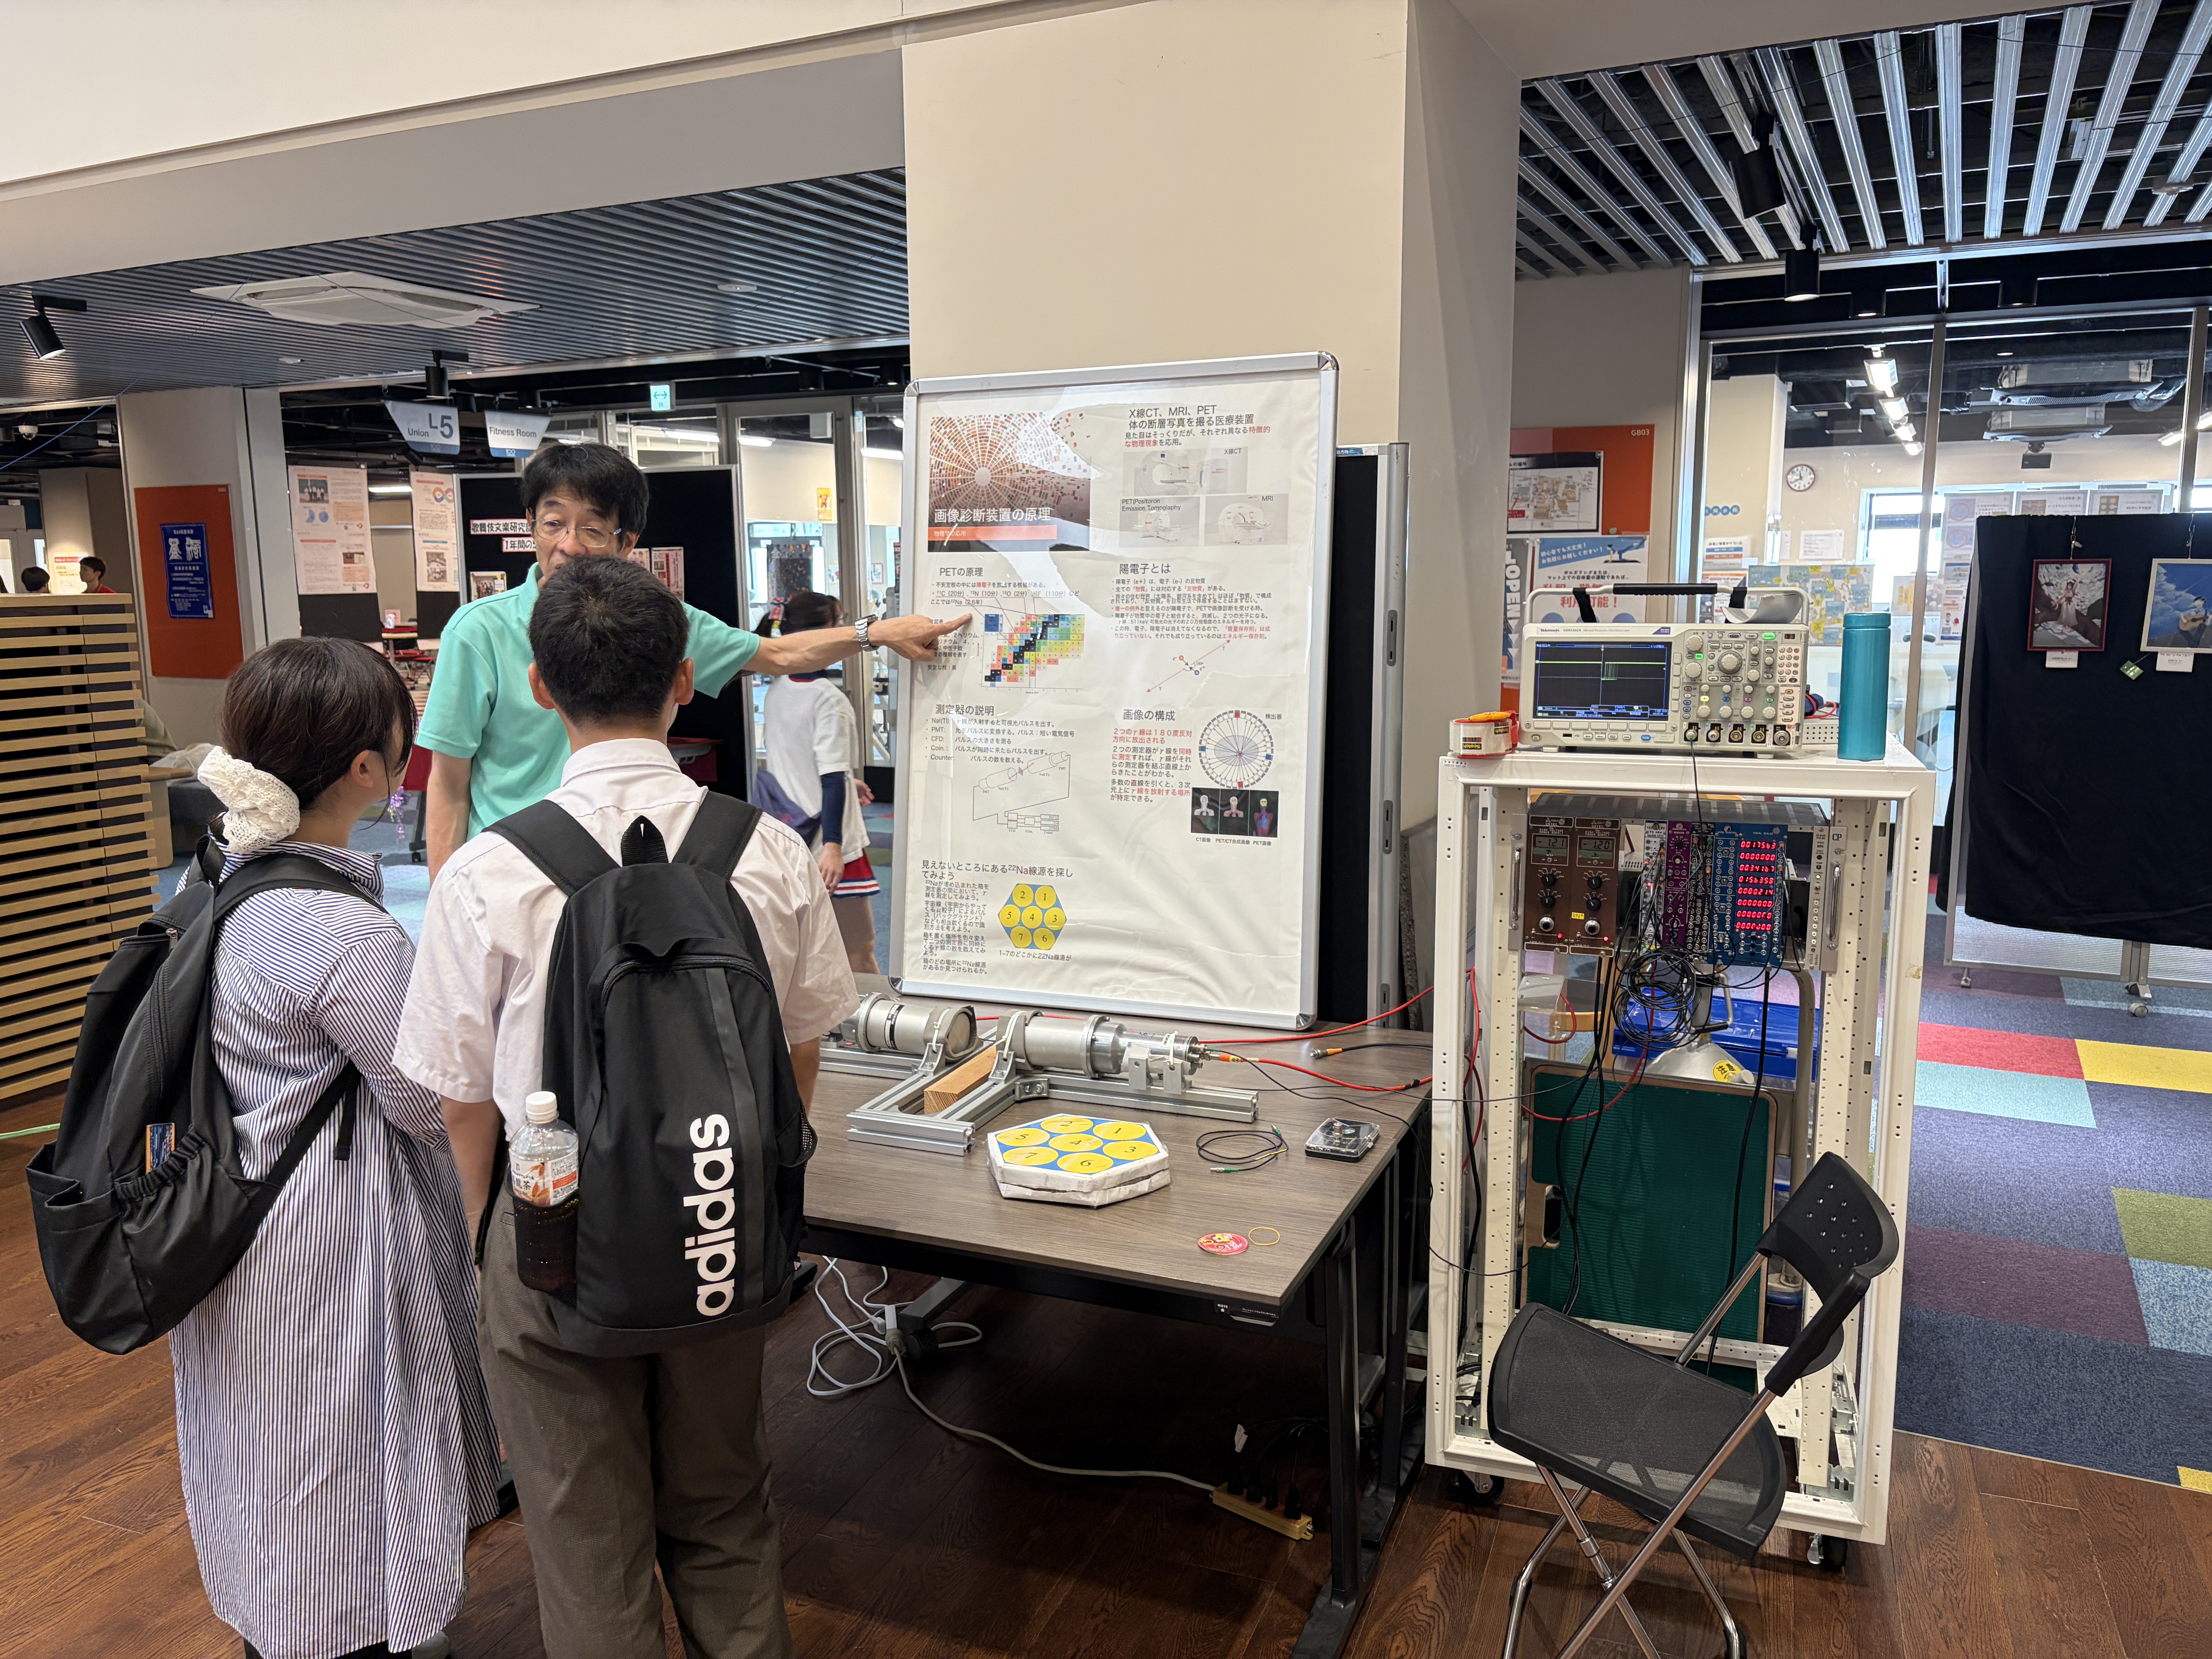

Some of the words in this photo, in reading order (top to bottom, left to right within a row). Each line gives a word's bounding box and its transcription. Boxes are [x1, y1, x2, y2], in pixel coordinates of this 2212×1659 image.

[1129, 405, 1217, 418] X線CT、MRI、PET
[428, 413, 454, 439] L5
[1128, 414, 1254, 430] 体の断層写真を撮る医療装置
[408, 428, 429, 437] Union
[489, 426, 515, 436] Fitness
[516, 428, 537, 438] Room
[1125, 426, 1271, 440] 見た目はそっくりだが、それぞれ異なる特徴的
[1125, 438, 1182, 448] な物理現象を応用。
[934, 508, 1051, 523] 画像診断装置の原理
[939, 567, 983, 577] PETの原理
[1119, 563, 1171, 575] 陽電子とは
[935, 704, 995, 716] 測定器の説明
[1123, 709, 1176, 721] 画像の構成
[1112, 736, 1166, 744] 方向に放出される
[1111, 761, 1192, 771] らの測定器を結ぶ直線上か
[1111, 769, 1175, 778] らきたことがわかる。
[1110, 794, 1154, 803] が特定できる。
[1740, 852, 1775, 861] 0000000
[921, 871, 955, 880] てみよう
[1020, 891, 1026, 899] 2
[1043, 893, 1047, 901] 1
[1006, 912, 1012, 920] 5
[1029, 913, 1035, 922] 4
[1052, 915, 1058, 923] 3
[1018, 933, 1024, 942] 7
[1042, 934, 1048, 943] 6
[923, 964, 988, 975] があるか見つけられるか。
[683, 1114, 735, 1317] adidas
